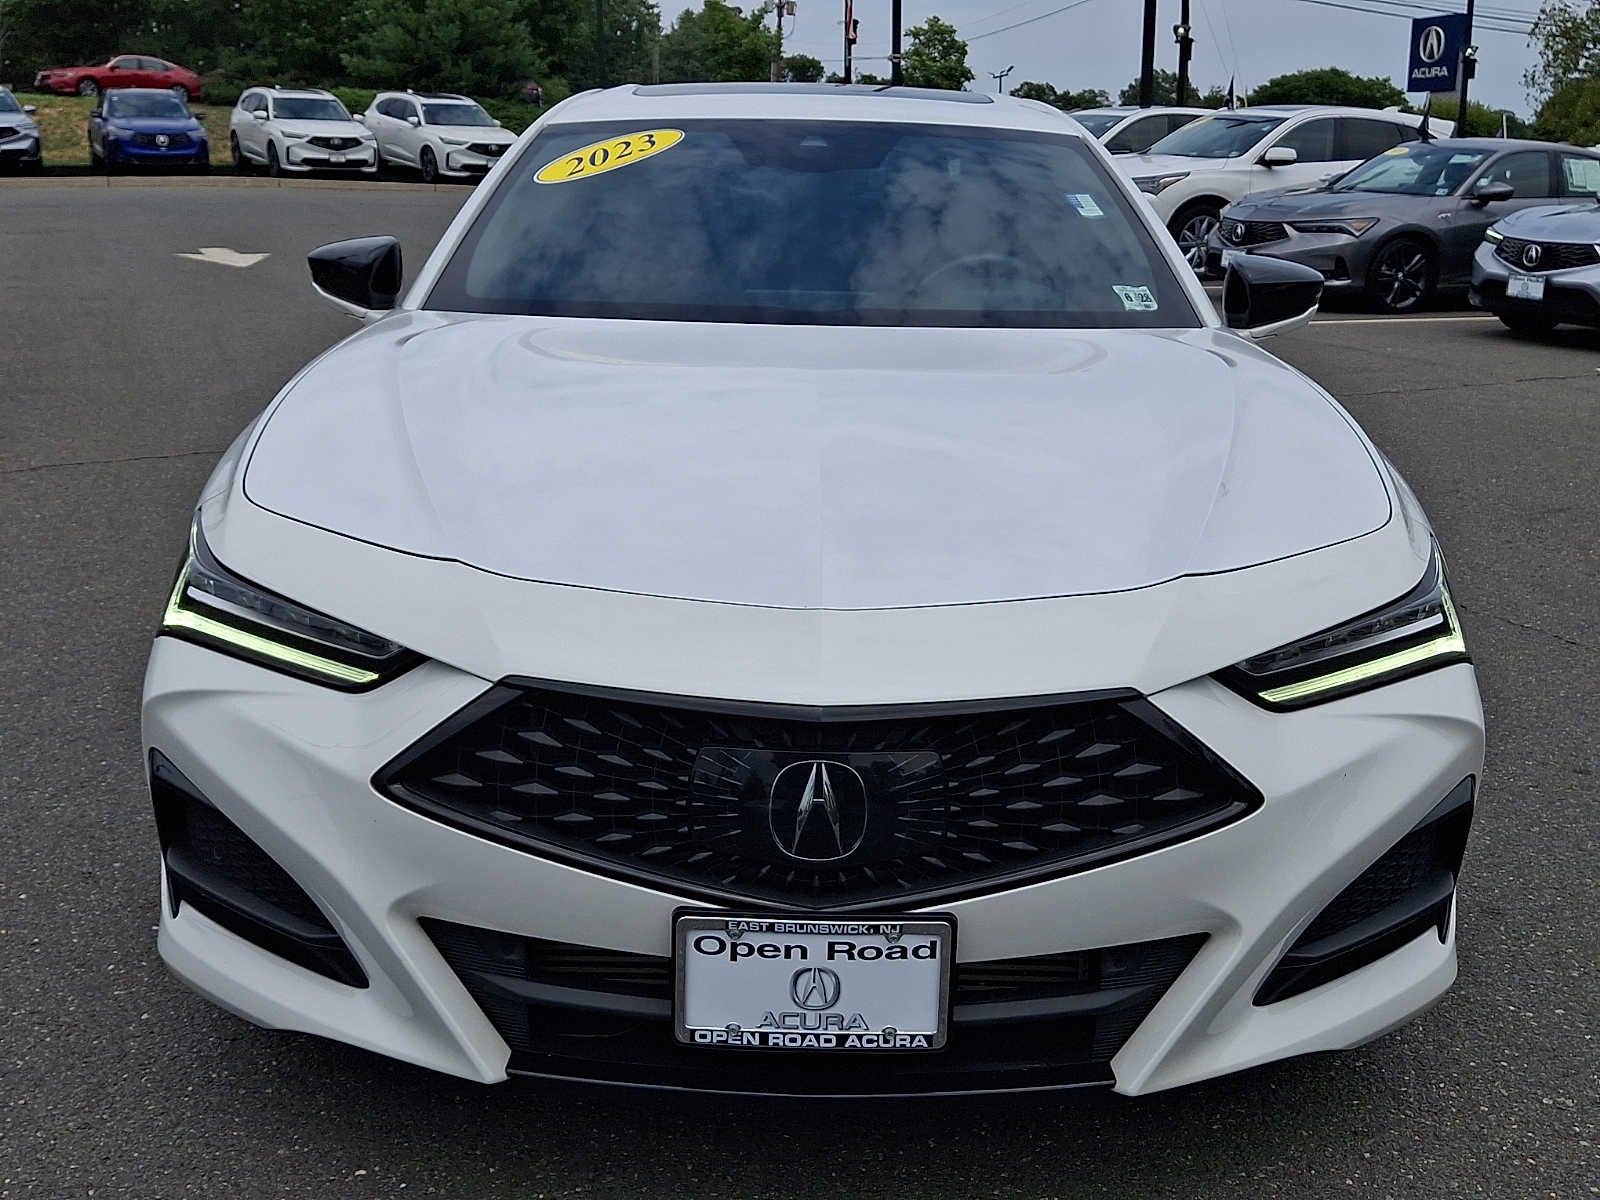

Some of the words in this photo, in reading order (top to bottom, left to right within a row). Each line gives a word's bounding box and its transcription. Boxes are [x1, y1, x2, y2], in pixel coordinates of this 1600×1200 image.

[1411, 66, 1448, 79] ACURA
[565, 133, 656, 176] 2023
[728, 921, 769, 931] EAST
[774, 923, 874, 935] BRUNSWICK,
[879, 924, 900, 934] NJ
[693, 935, 808, 962] Open
[827, 940, 938, 960] Road
[758, 1010, 869, 1031] ACURA
[694, 1030, 760, 1045] OPEN
[768, 1033, 837, 1047] ROAD
[844, 1034, 929, 1048] ACURA
